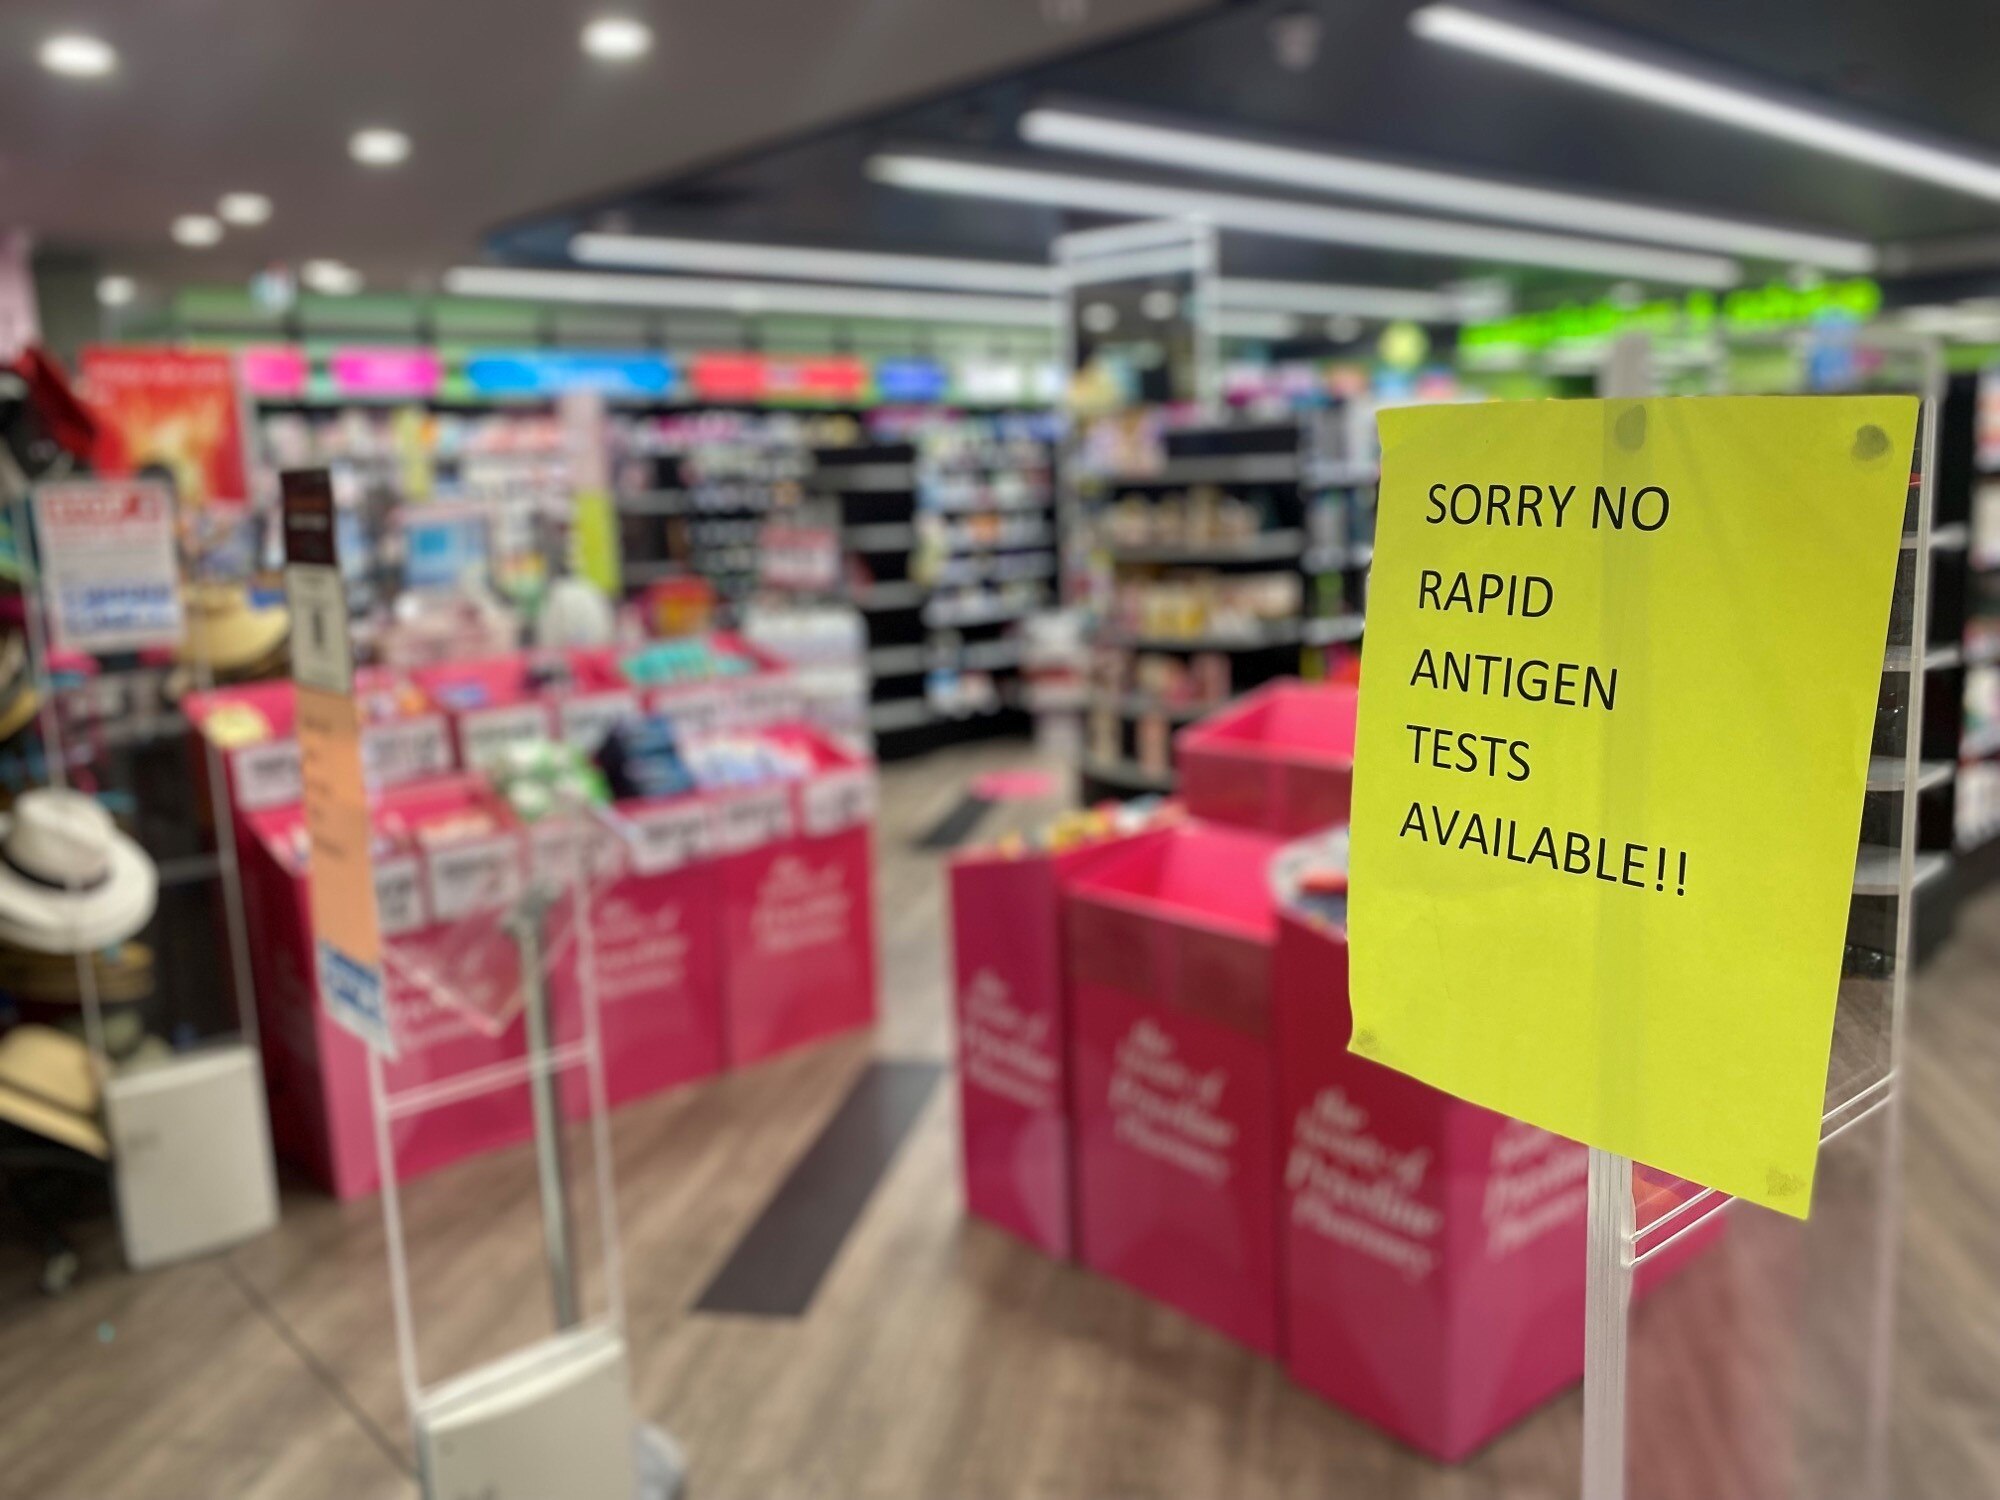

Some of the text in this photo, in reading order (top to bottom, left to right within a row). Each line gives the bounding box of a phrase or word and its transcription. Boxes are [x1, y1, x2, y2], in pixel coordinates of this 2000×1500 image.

[1426, 483, 1670, 532] SORRY NO
[1418, 570, 1554, 618] RAPID
[1409, 648, 1618, 711] ANTIGEN
[1406, 724, 1530, 782] TESTS
[1399, 802, 1687, 897] AVAILABLE!!
